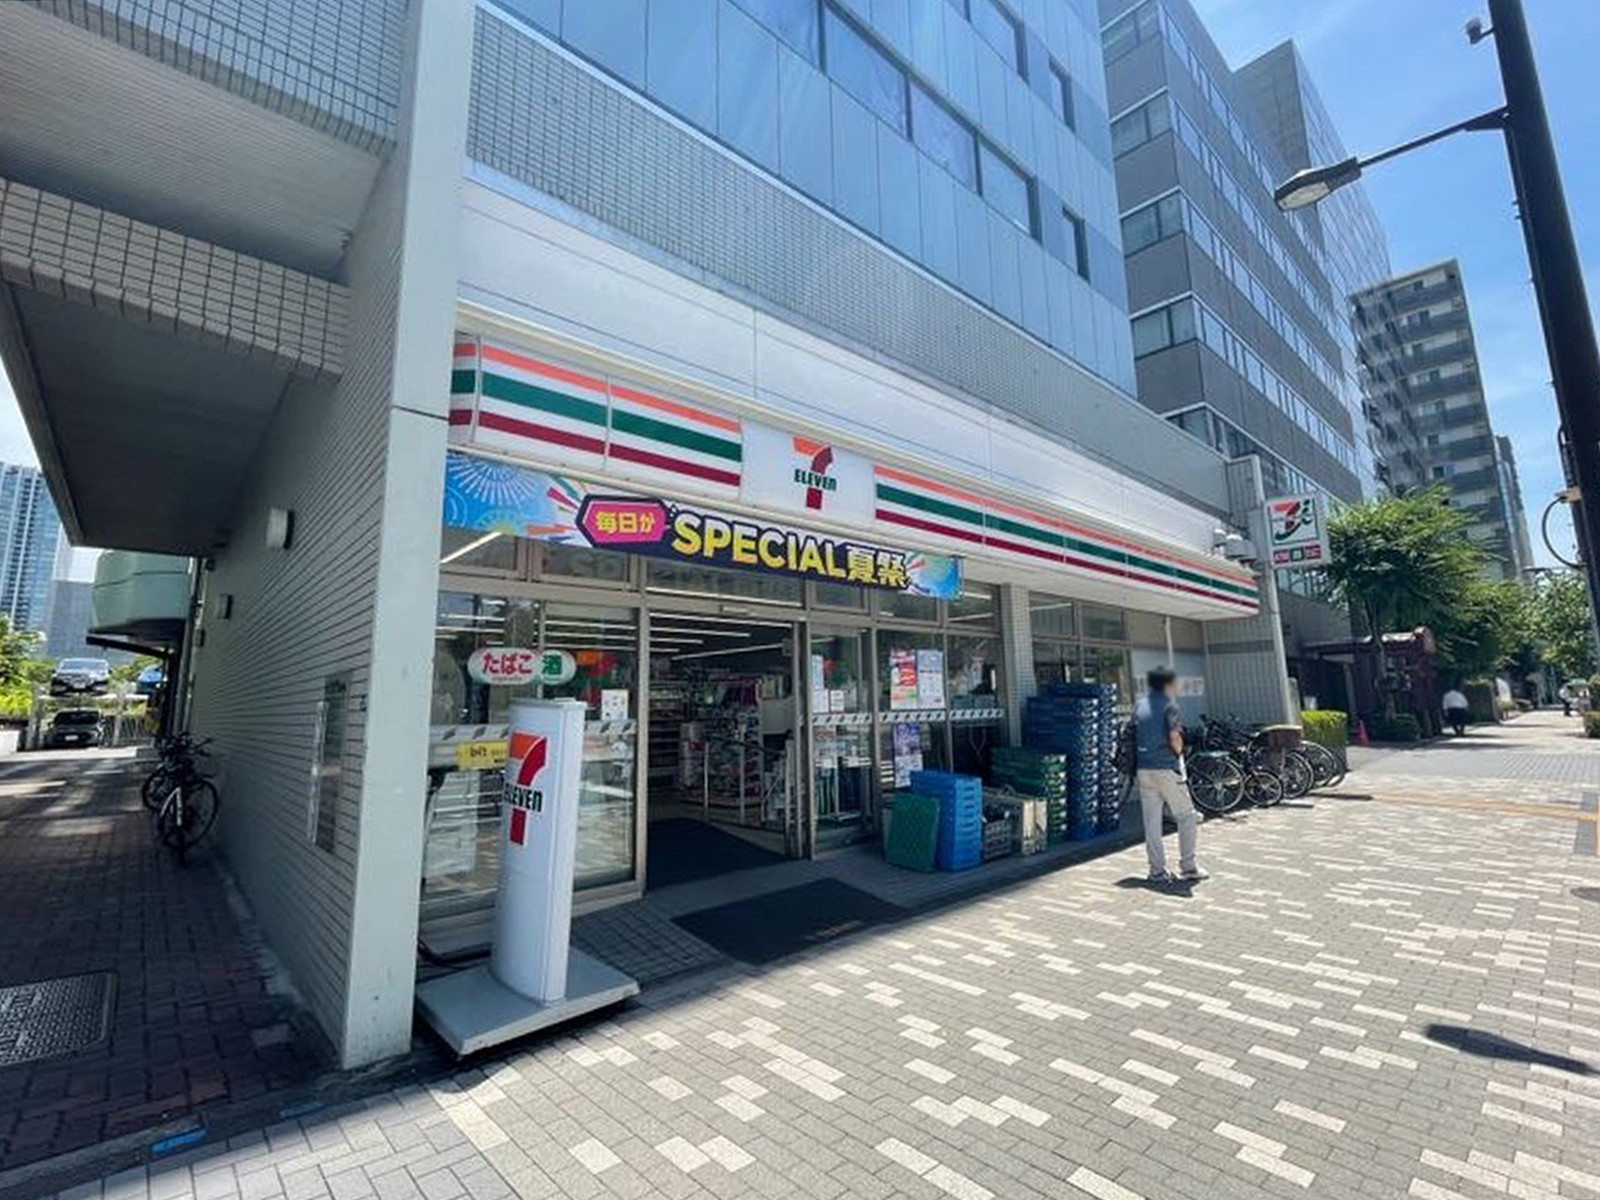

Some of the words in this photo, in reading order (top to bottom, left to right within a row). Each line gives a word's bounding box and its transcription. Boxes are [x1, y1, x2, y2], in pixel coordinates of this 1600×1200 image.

[482, 652, 533, 675] たばこ
[541, 653, 563, 676] 酒
